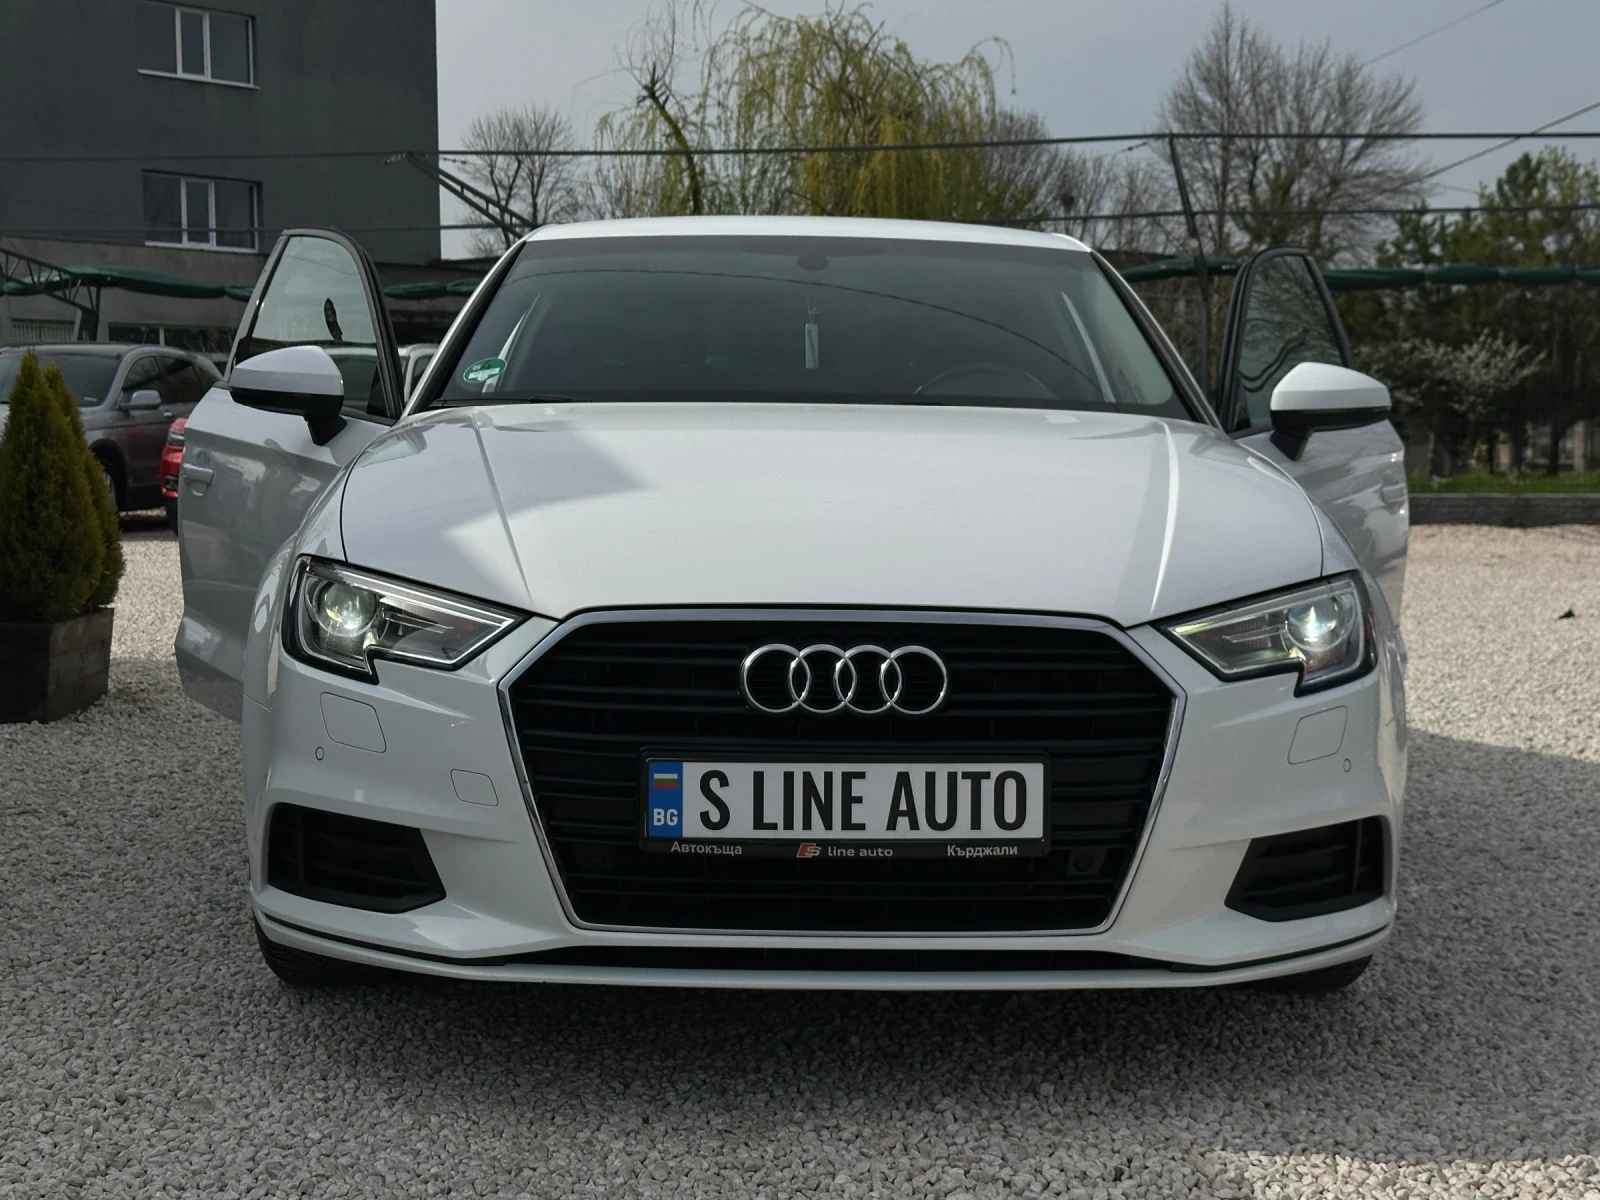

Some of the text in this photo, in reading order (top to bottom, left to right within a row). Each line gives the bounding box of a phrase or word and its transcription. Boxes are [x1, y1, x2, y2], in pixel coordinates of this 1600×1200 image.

[699, 769, 1027, 831] S LINE AUTO
[653, 808, 678, 826] BG
[670, 841, 742, 856] Автокъща
[828, 846, 854, 857] line
[859, 847, 893, 857] auto
[947, 844, 1018, 858] Кърджали
